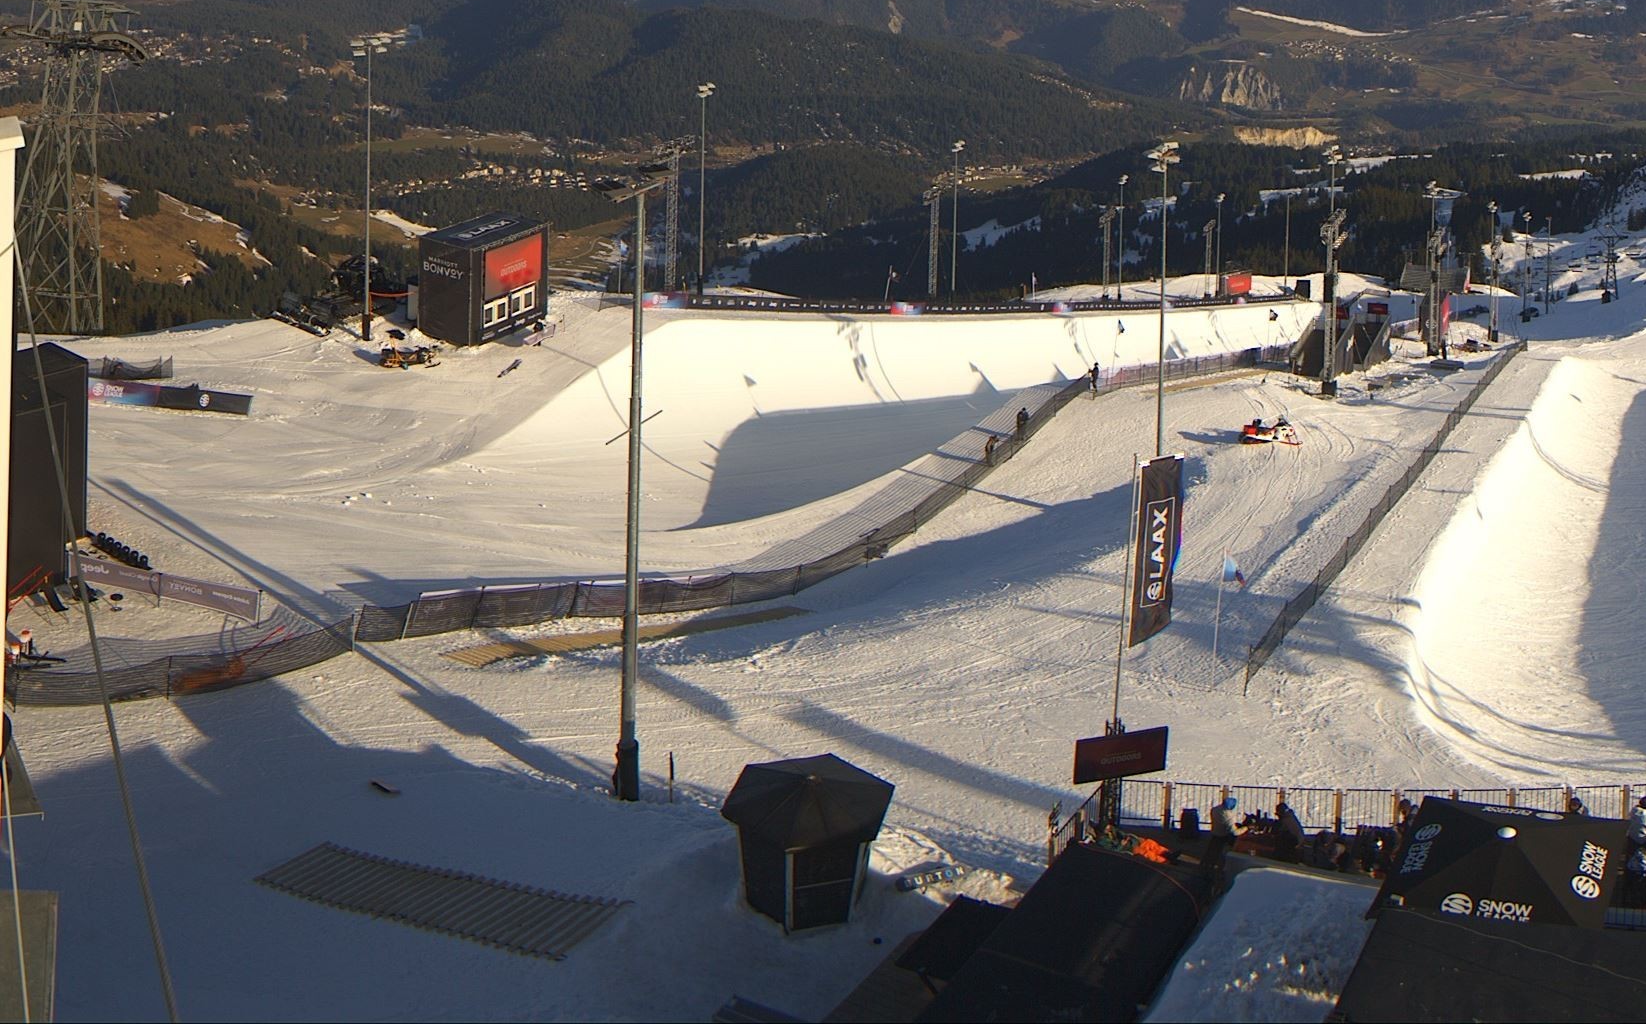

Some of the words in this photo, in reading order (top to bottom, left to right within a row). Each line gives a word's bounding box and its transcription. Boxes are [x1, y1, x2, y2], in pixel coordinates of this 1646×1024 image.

[423, 261, 464, 280] BONVOY
[428, 256, 459, 269] MARRIOTT
[1149, 507, 1168, 578] LAAX
[1579, 841, 1598, 875] SNOW
[1591, 845, 1608, 880] LEAGUE
[1477, 899, 1533, 918] SNOW
